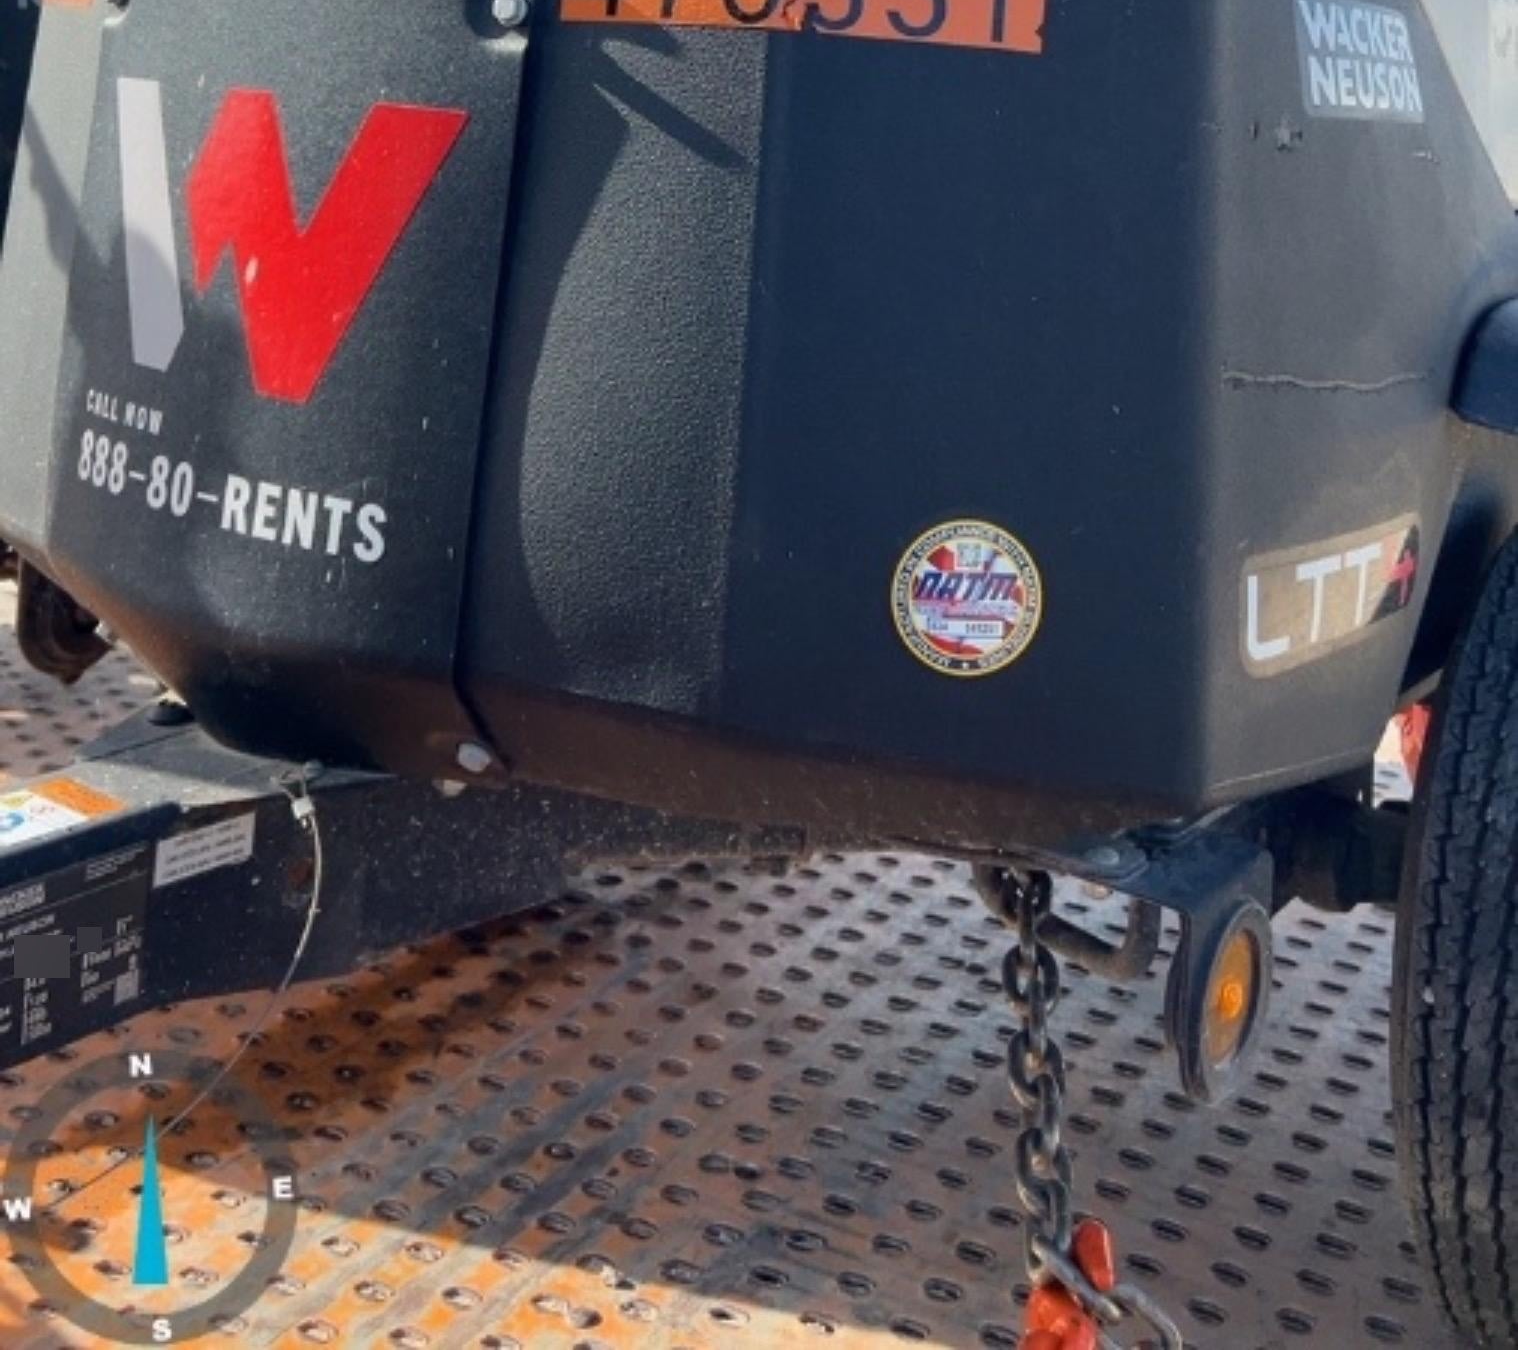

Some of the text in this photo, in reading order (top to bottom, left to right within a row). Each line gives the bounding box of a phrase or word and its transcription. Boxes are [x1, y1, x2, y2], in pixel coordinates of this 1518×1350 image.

[1298, 0, 1414, 64] WACKER
[1307, 54, 1424, 112] NEUSON
[86, 388, 163, 435] CALL NOW
[77, 428, 388, 562] 888-80-RENTS
